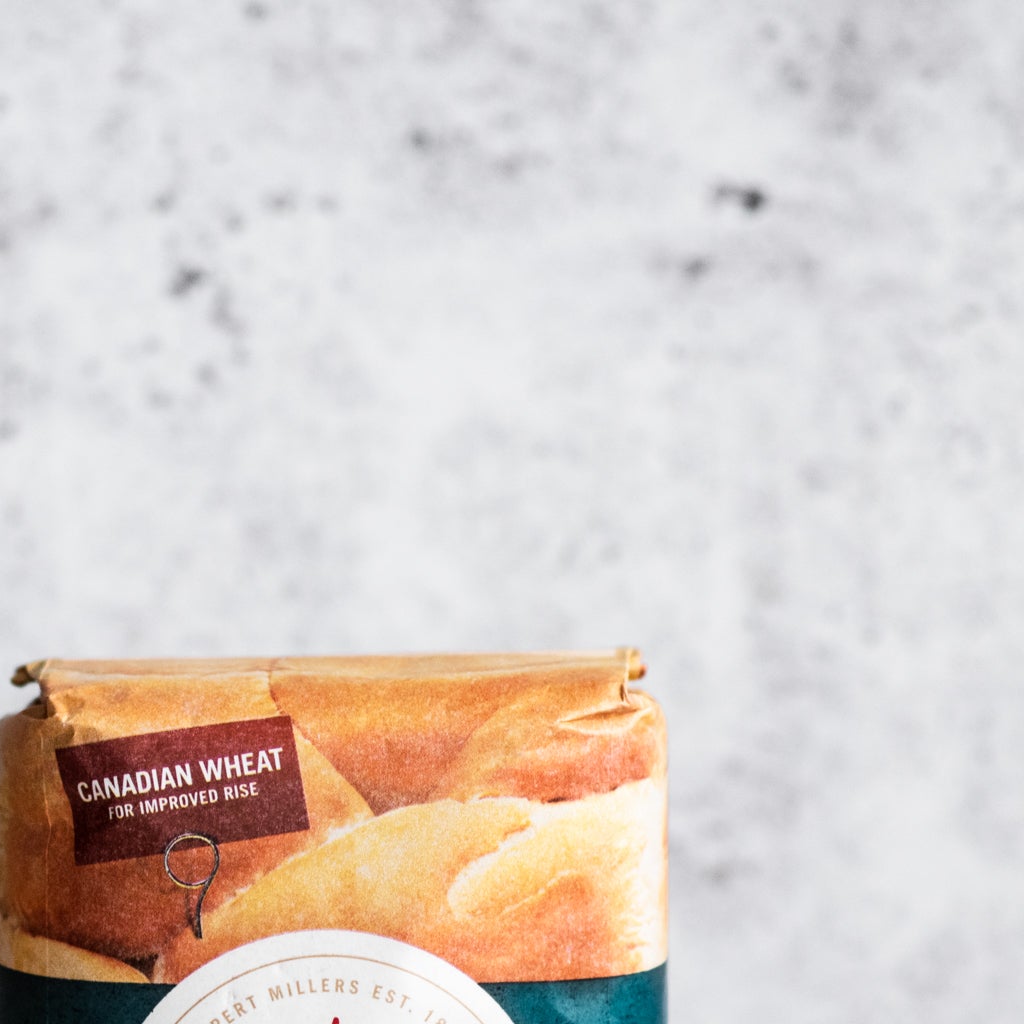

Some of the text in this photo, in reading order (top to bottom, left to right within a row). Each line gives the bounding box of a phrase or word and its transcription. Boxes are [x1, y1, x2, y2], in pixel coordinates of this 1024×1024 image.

[77, 747, 284, 803] CANADIAN WHEAT
[108, 782, 259, 820] FOR IMPROVED RISE
[269, 978, 360, 1003] MILLERS
[371, 984, 413, 1014] EST.
